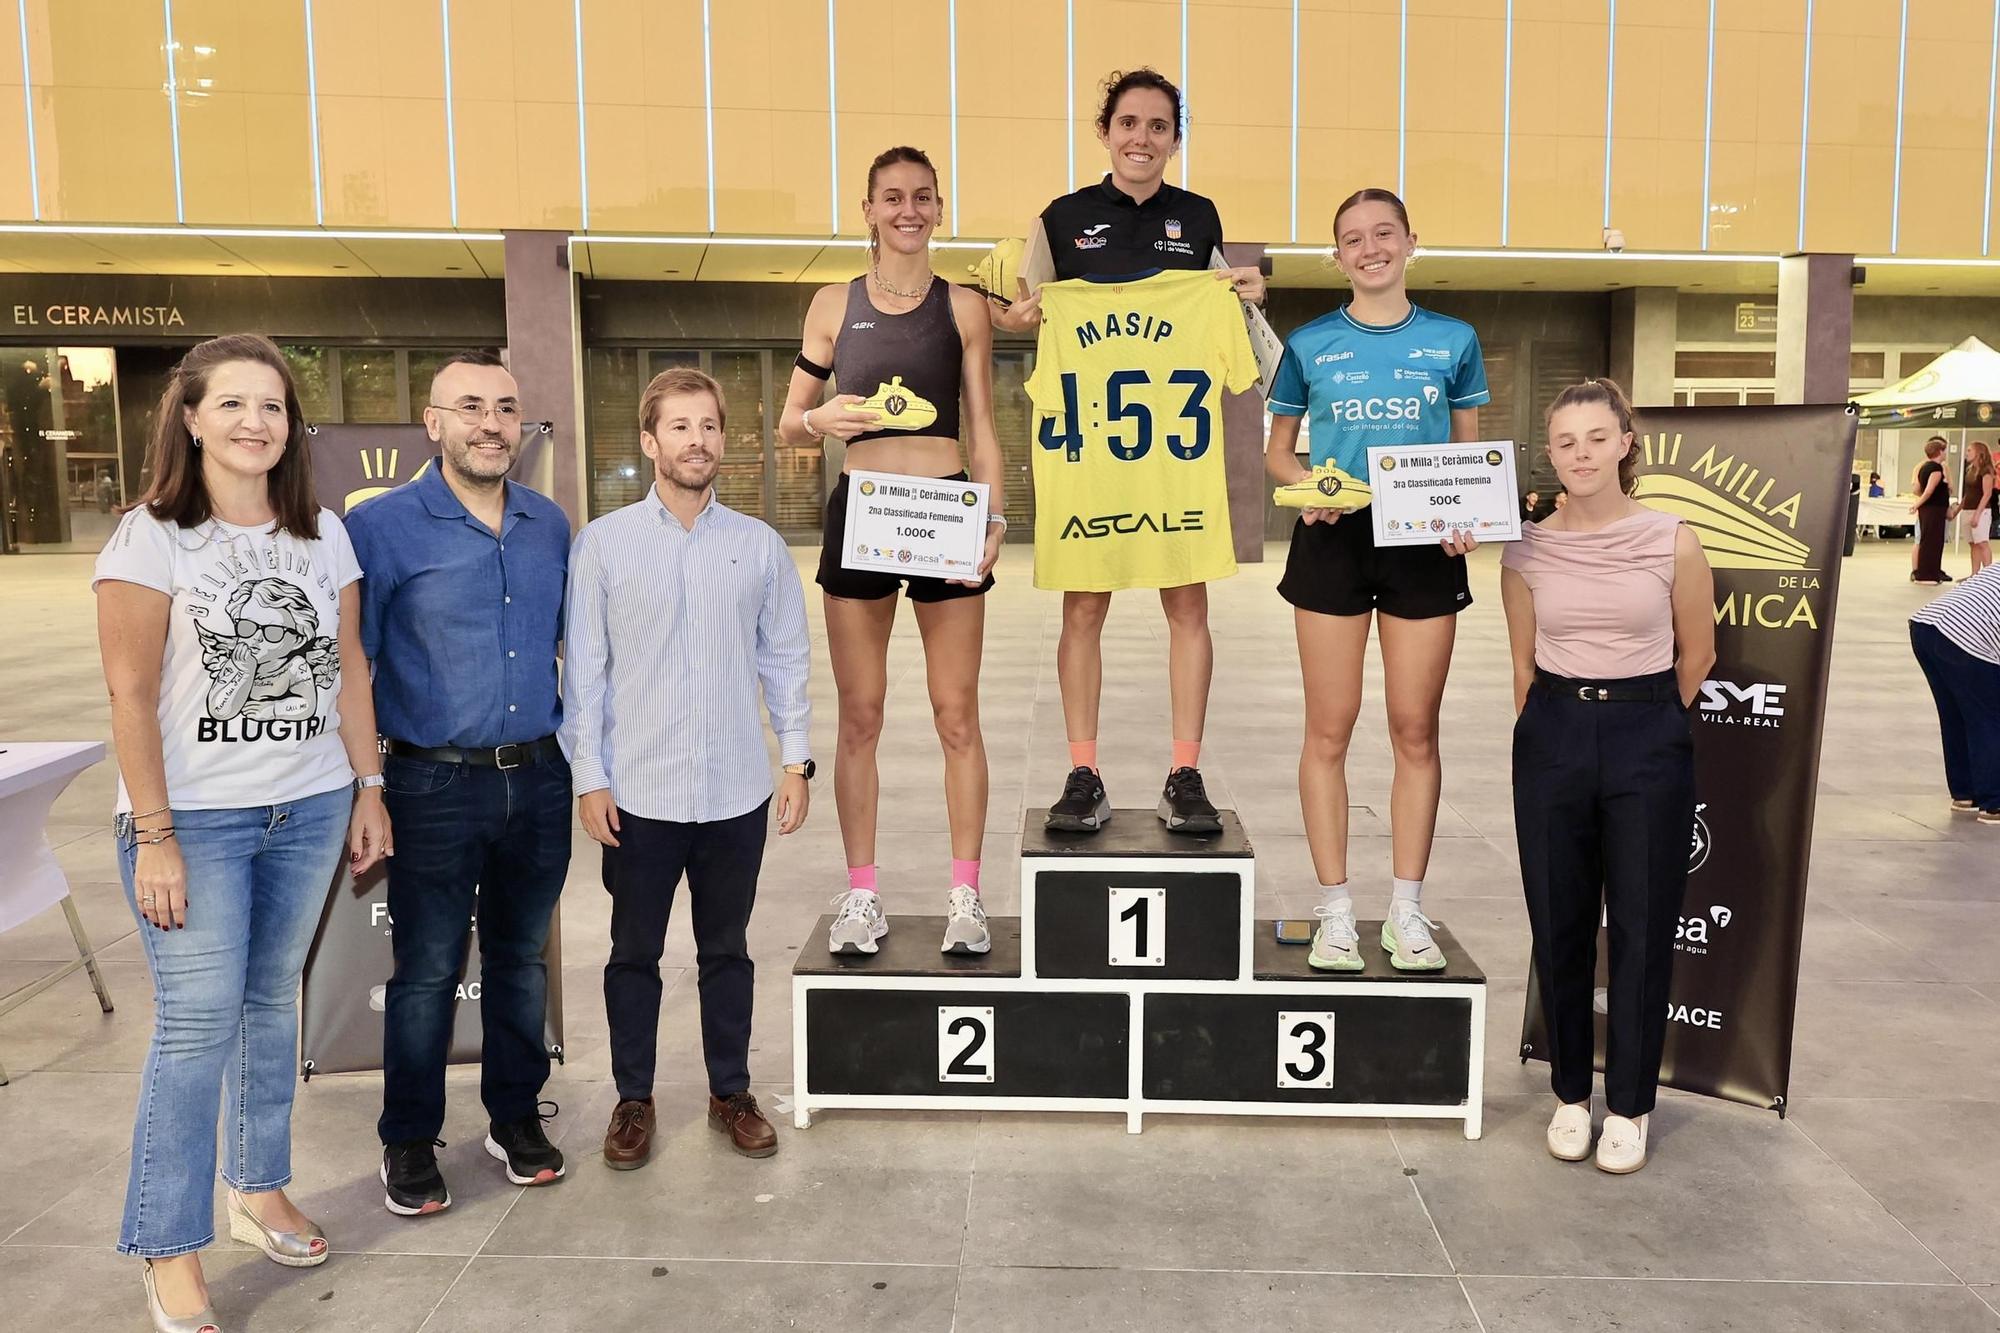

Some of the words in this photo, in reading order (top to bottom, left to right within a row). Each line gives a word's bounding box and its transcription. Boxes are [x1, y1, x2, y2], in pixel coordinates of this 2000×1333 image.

[14, 305, 39, 325] EL
[46, 305, 185, 326] CERAMISTA
[851, 321, 876, 330] 42K
[1740, 315, 1755, 328] 23
[1075, 312, 1174, 349] MASIP
[1038, 369, 1212, 462] 4:53
[1331, 398, 1421, 424] Facsa
[1361, 421, 1390, 432] integral
[1391, 421, 1404, 430] del
[1400, 458, 1409, 468] III
[1410, 457, 1433, 468] Milla
[1442, 453, 1484, 466] Ceràmica
[1393, 479, 1406, 489] 3ra
[1407, 476, 1453, 489] Classificada
[1455, 475, 1492, 486] Femenina
[1643, 432, 1683, 466] III
[1689, 444, 1803, 529] MILLA
[879, 485, 888, 496] III
[889, 486, 910, 498] Milla
[919, 488, 960, 503] Ceràmica
[1429, 494, 1462, 506] 500€
[868, 505, 882, 516] 2na
[883, 507, 928, 520] Classificada
[929, 511, 964, 524] Femenina
[1060, 510, 1204, 539] ASCALE
[896, 526, 936, 540] 1.000€
[184, 548, 278, 618] BELIEVE
[286, 551, 310, 577] IN
[1779, 575, 1797, 589] DE
[1801, 577, 1820, 589] LA
[1712, 592, 1818, 629] MICA
[1699, 679, 1787, 716] SME
[1700, 712, 1780, 728] VILA-REAL
[1120, 897, 1148, 958] 1
[1686, 945, 1707, 955] agua
[946, 1016, 986, 1075] 2
[1285, 1021, 1326, 1081] 3
